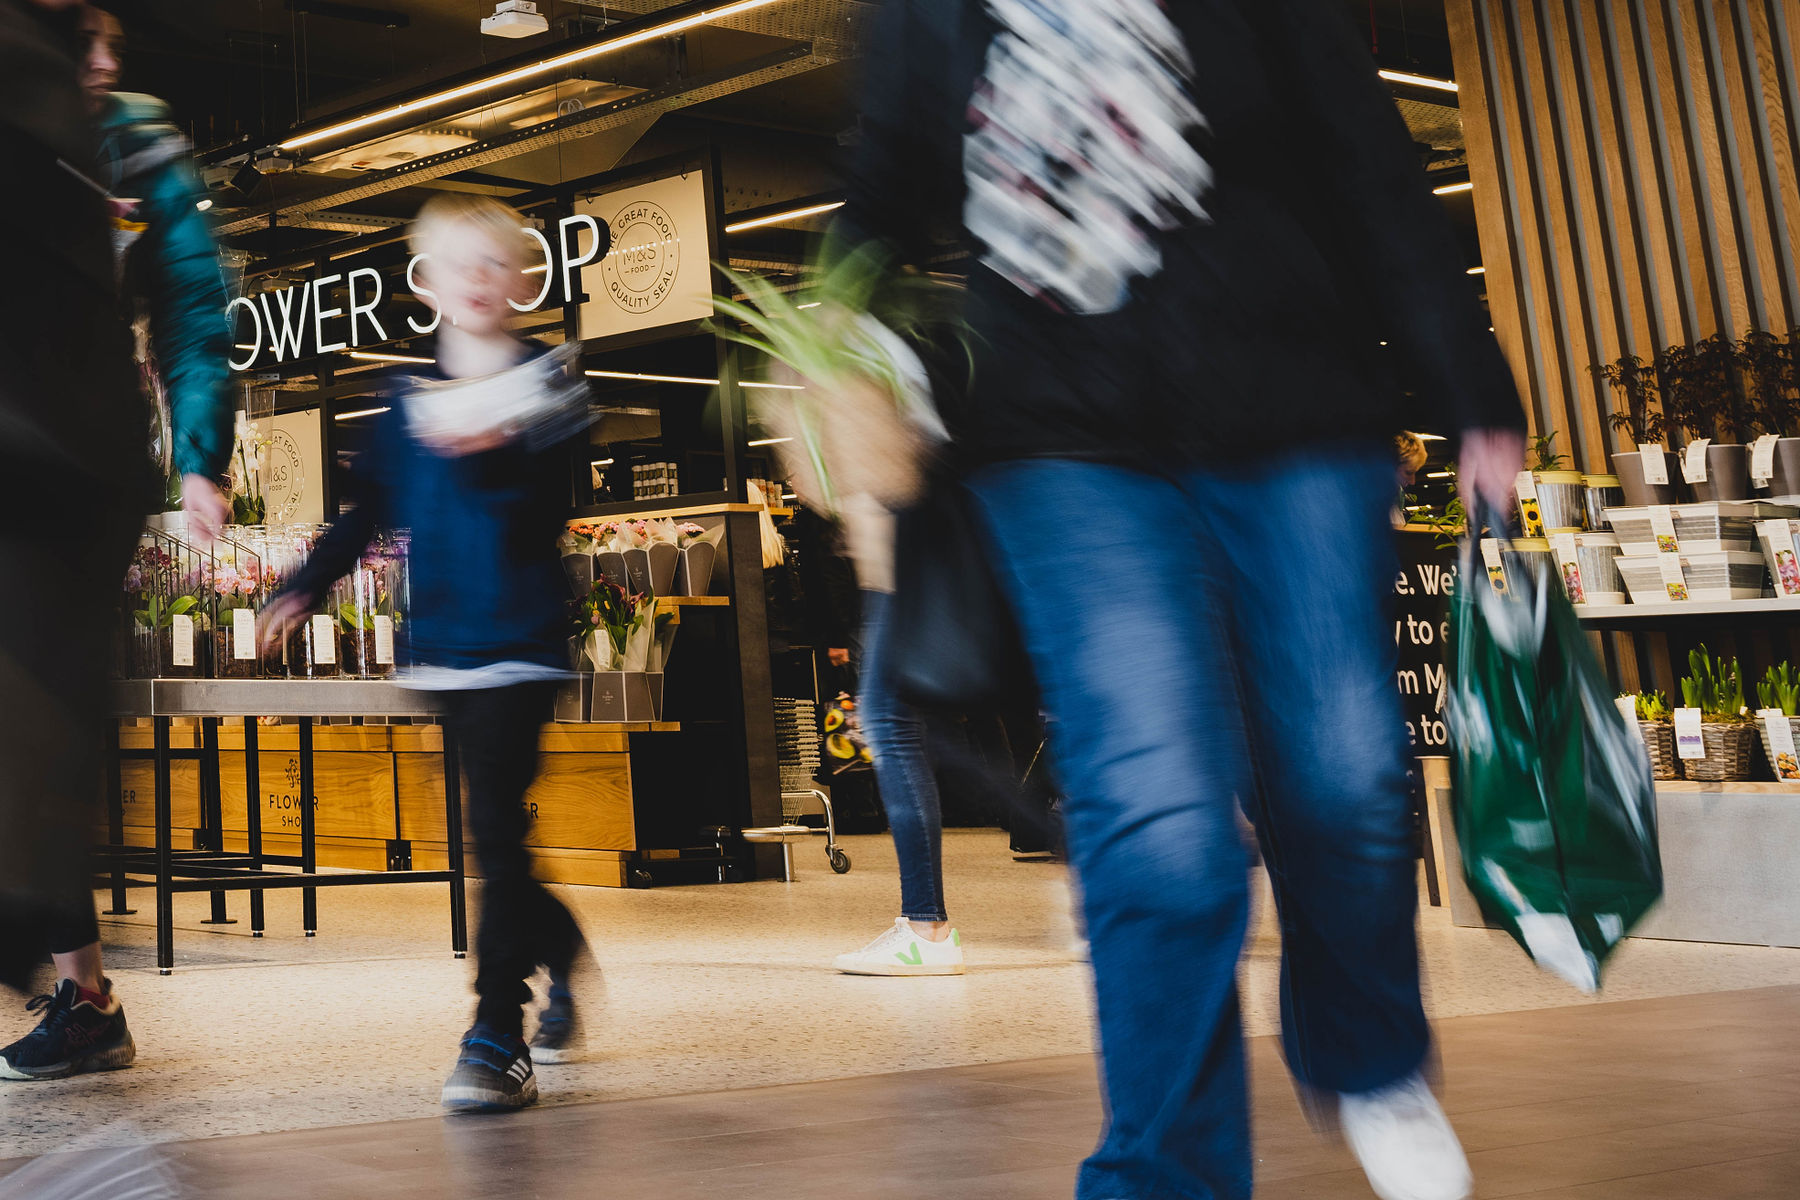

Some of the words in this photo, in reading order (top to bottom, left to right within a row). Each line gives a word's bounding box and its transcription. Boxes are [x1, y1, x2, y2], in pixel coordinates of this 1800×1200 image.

[618, 208, 648, 229] GREAT
[650, 211, 673, 241] FOOD
[622, 241, 657, 266] M&S
[630, 264, 650, 274] FOOD
[406, 213, 601, 334] SOP
[610, 280, 650, 308] QUALITY
[653, 269, 674, 300] SEAL
[1406, 613, 1434, 645] to
[1420, 713, 1448, 746] to
[269, 794, 319, 811] FLOWR
[281, 815, 301, 828] SHO
